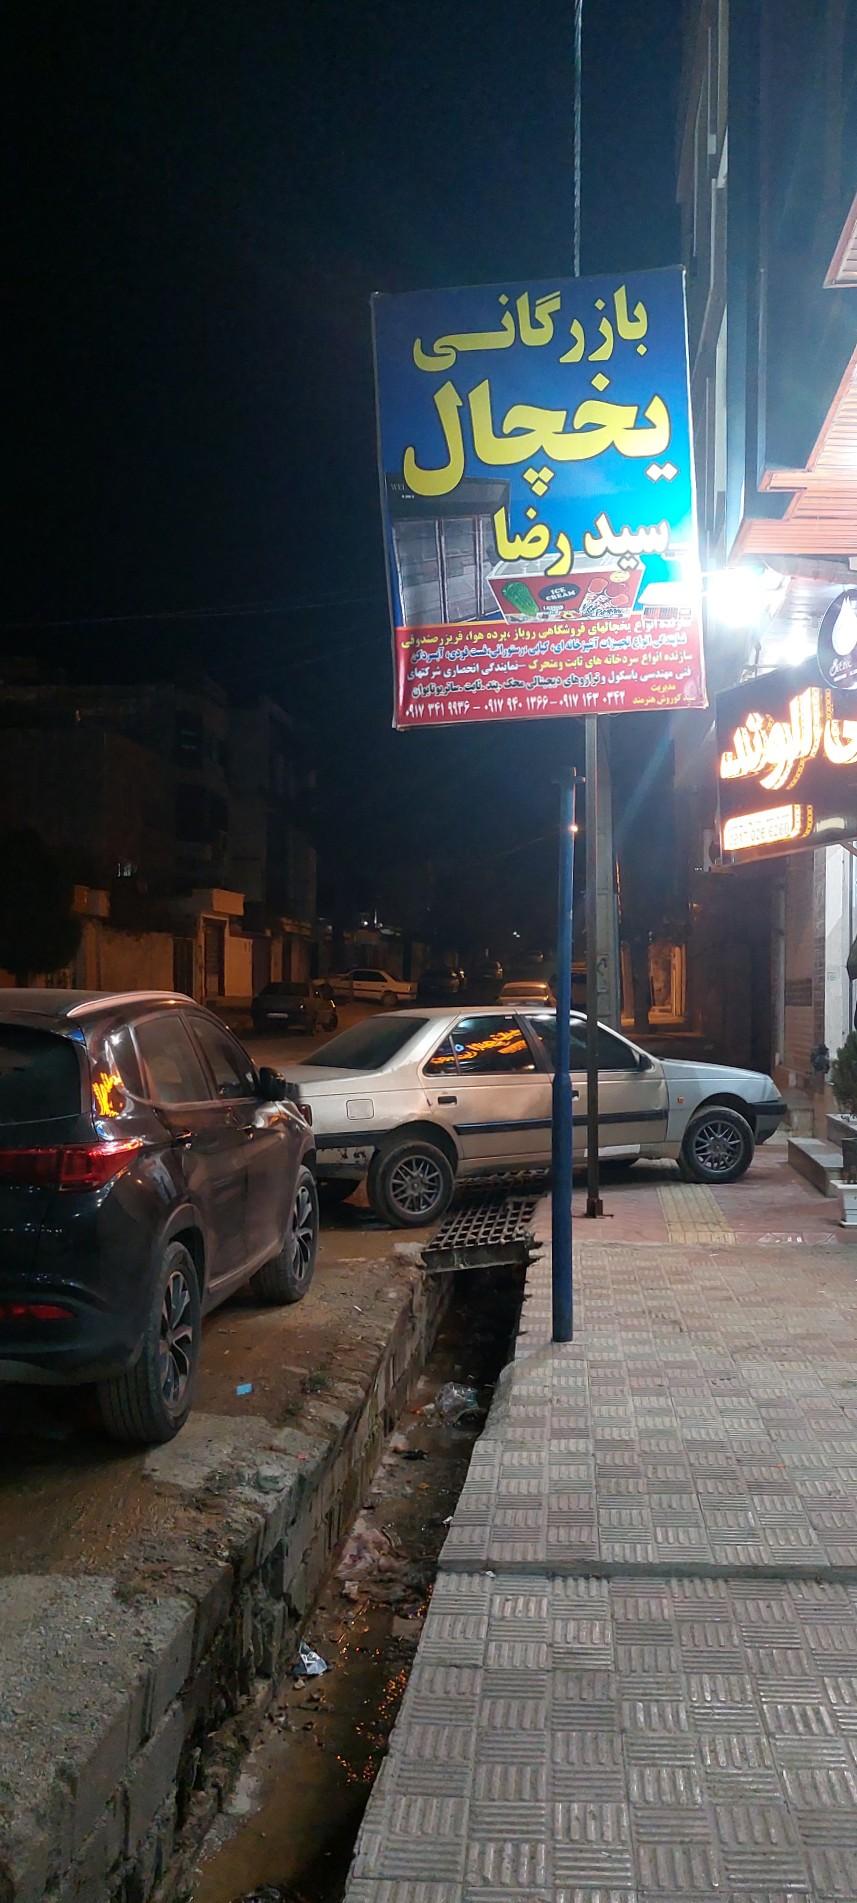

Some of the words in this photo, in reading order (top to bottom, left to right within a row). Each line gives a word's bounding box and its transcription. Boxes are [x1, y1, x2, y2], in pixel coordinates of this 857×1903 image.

[413, 284, 648, 372] بازرگانی
[403, 372, 680, 497] یخچال
[493, 505, 575, 577] رضا
[584, 512, 671, 572] سید
[539, 622, 586, 639] فروشگاهی
[588, 620, 631, 635] یخچالهای
[634, 619, 658, 633] انواع
[513, 628, 536, 640] روباز
[585, 656, 602, 668] های
[641, 651, 662, 665] انواع
[664, 650, 693, 664] سازنده
[407, 665, 442, 680] شرکتهای
[443, 663, 480, 678] انحصاری
[607, 670, 639, 683] باسکول
[641, 670, 673, 681] مهندسی
[675, 667, 691, 679] فنی
[650, 683, 676, 693] مدیریت
[405, 703, 424, 718] ۰۹۱۷
[428, 702, 445, 717] ۳۴۱
[448, 700, 470, 716] ۹۹۳۶
[485, 699, 503, 713] ۰۹۱۷
[507, 697, 522, 711] ۹۴۰
[526, 695, 549, 710] ۱۳۶۶
[560, 693, 579, 708] ۰۹۱۷
[582, 692, 599, 707] ۱۴۳
